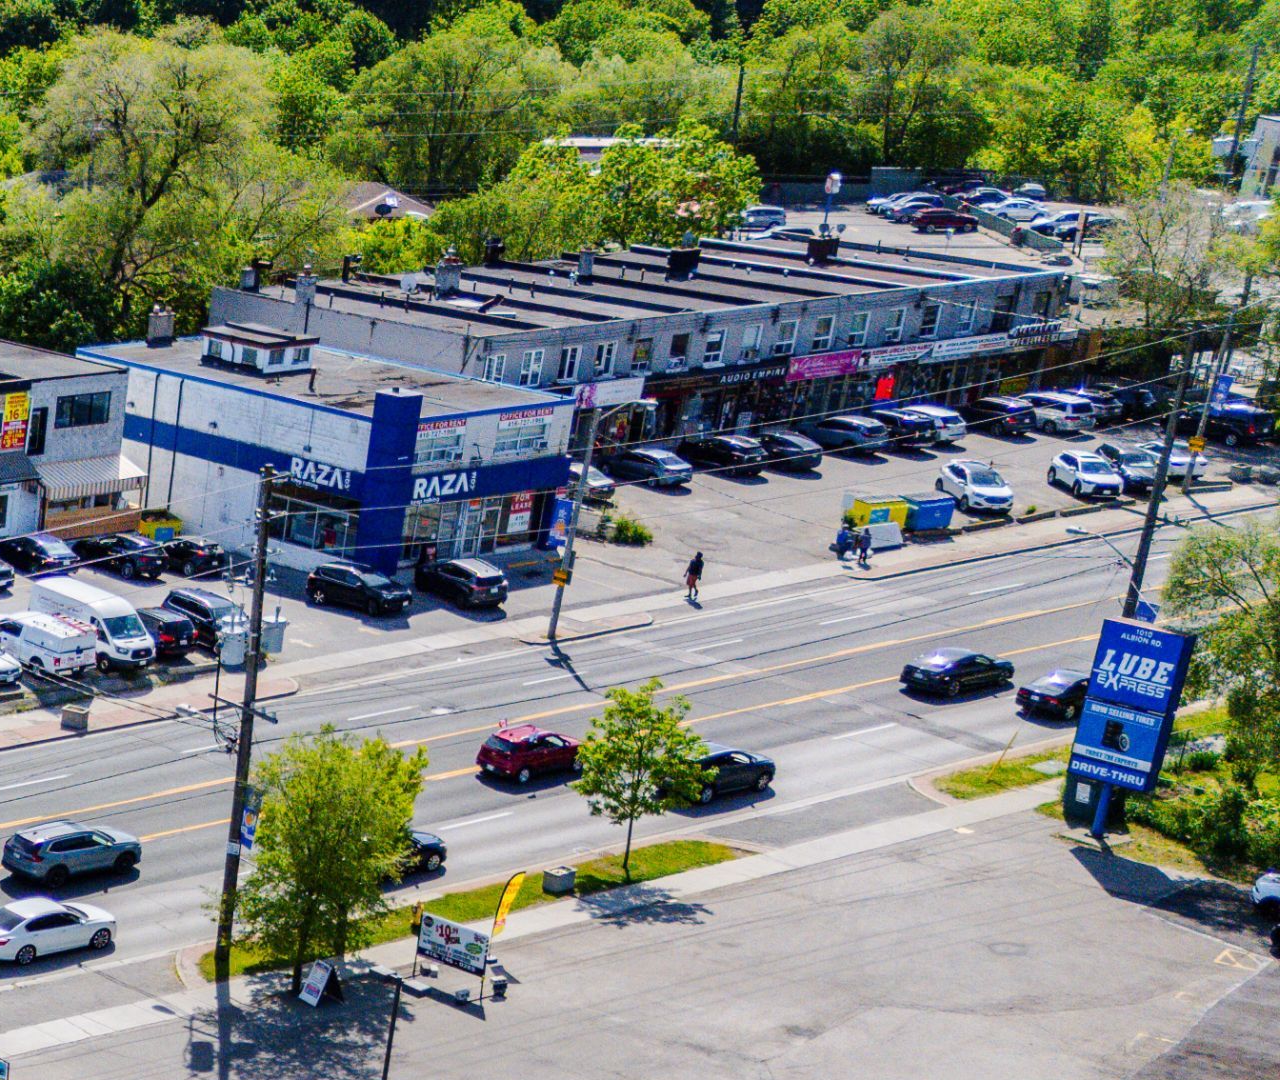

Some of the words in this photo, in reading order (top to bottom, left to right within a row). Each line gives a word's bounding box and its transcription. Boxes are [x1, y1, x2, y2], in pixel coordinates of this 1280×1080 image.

[720, 373, 750, 384] AUDIO
[752, 368, 786, 379] EMPIRE
[524, 410, 537, 418] FOR
[538, 408, 553, 417] RENT
[448, 420, 465, 428] RENT
[291, 456, 343, 490] RAZA
[413, 472, 468, 499] RAZA
[511, 501, 532, 510] LEASE
[1120, 632, 1149, 644] ALBION
[1136, 628, 1153, 638] 1010
[1099, 648, 1175, 685] LUBE
[1096, 670, 1166, 698] EXPRESS
[1071, 760, 1144, 786] DRIVE-THRU
